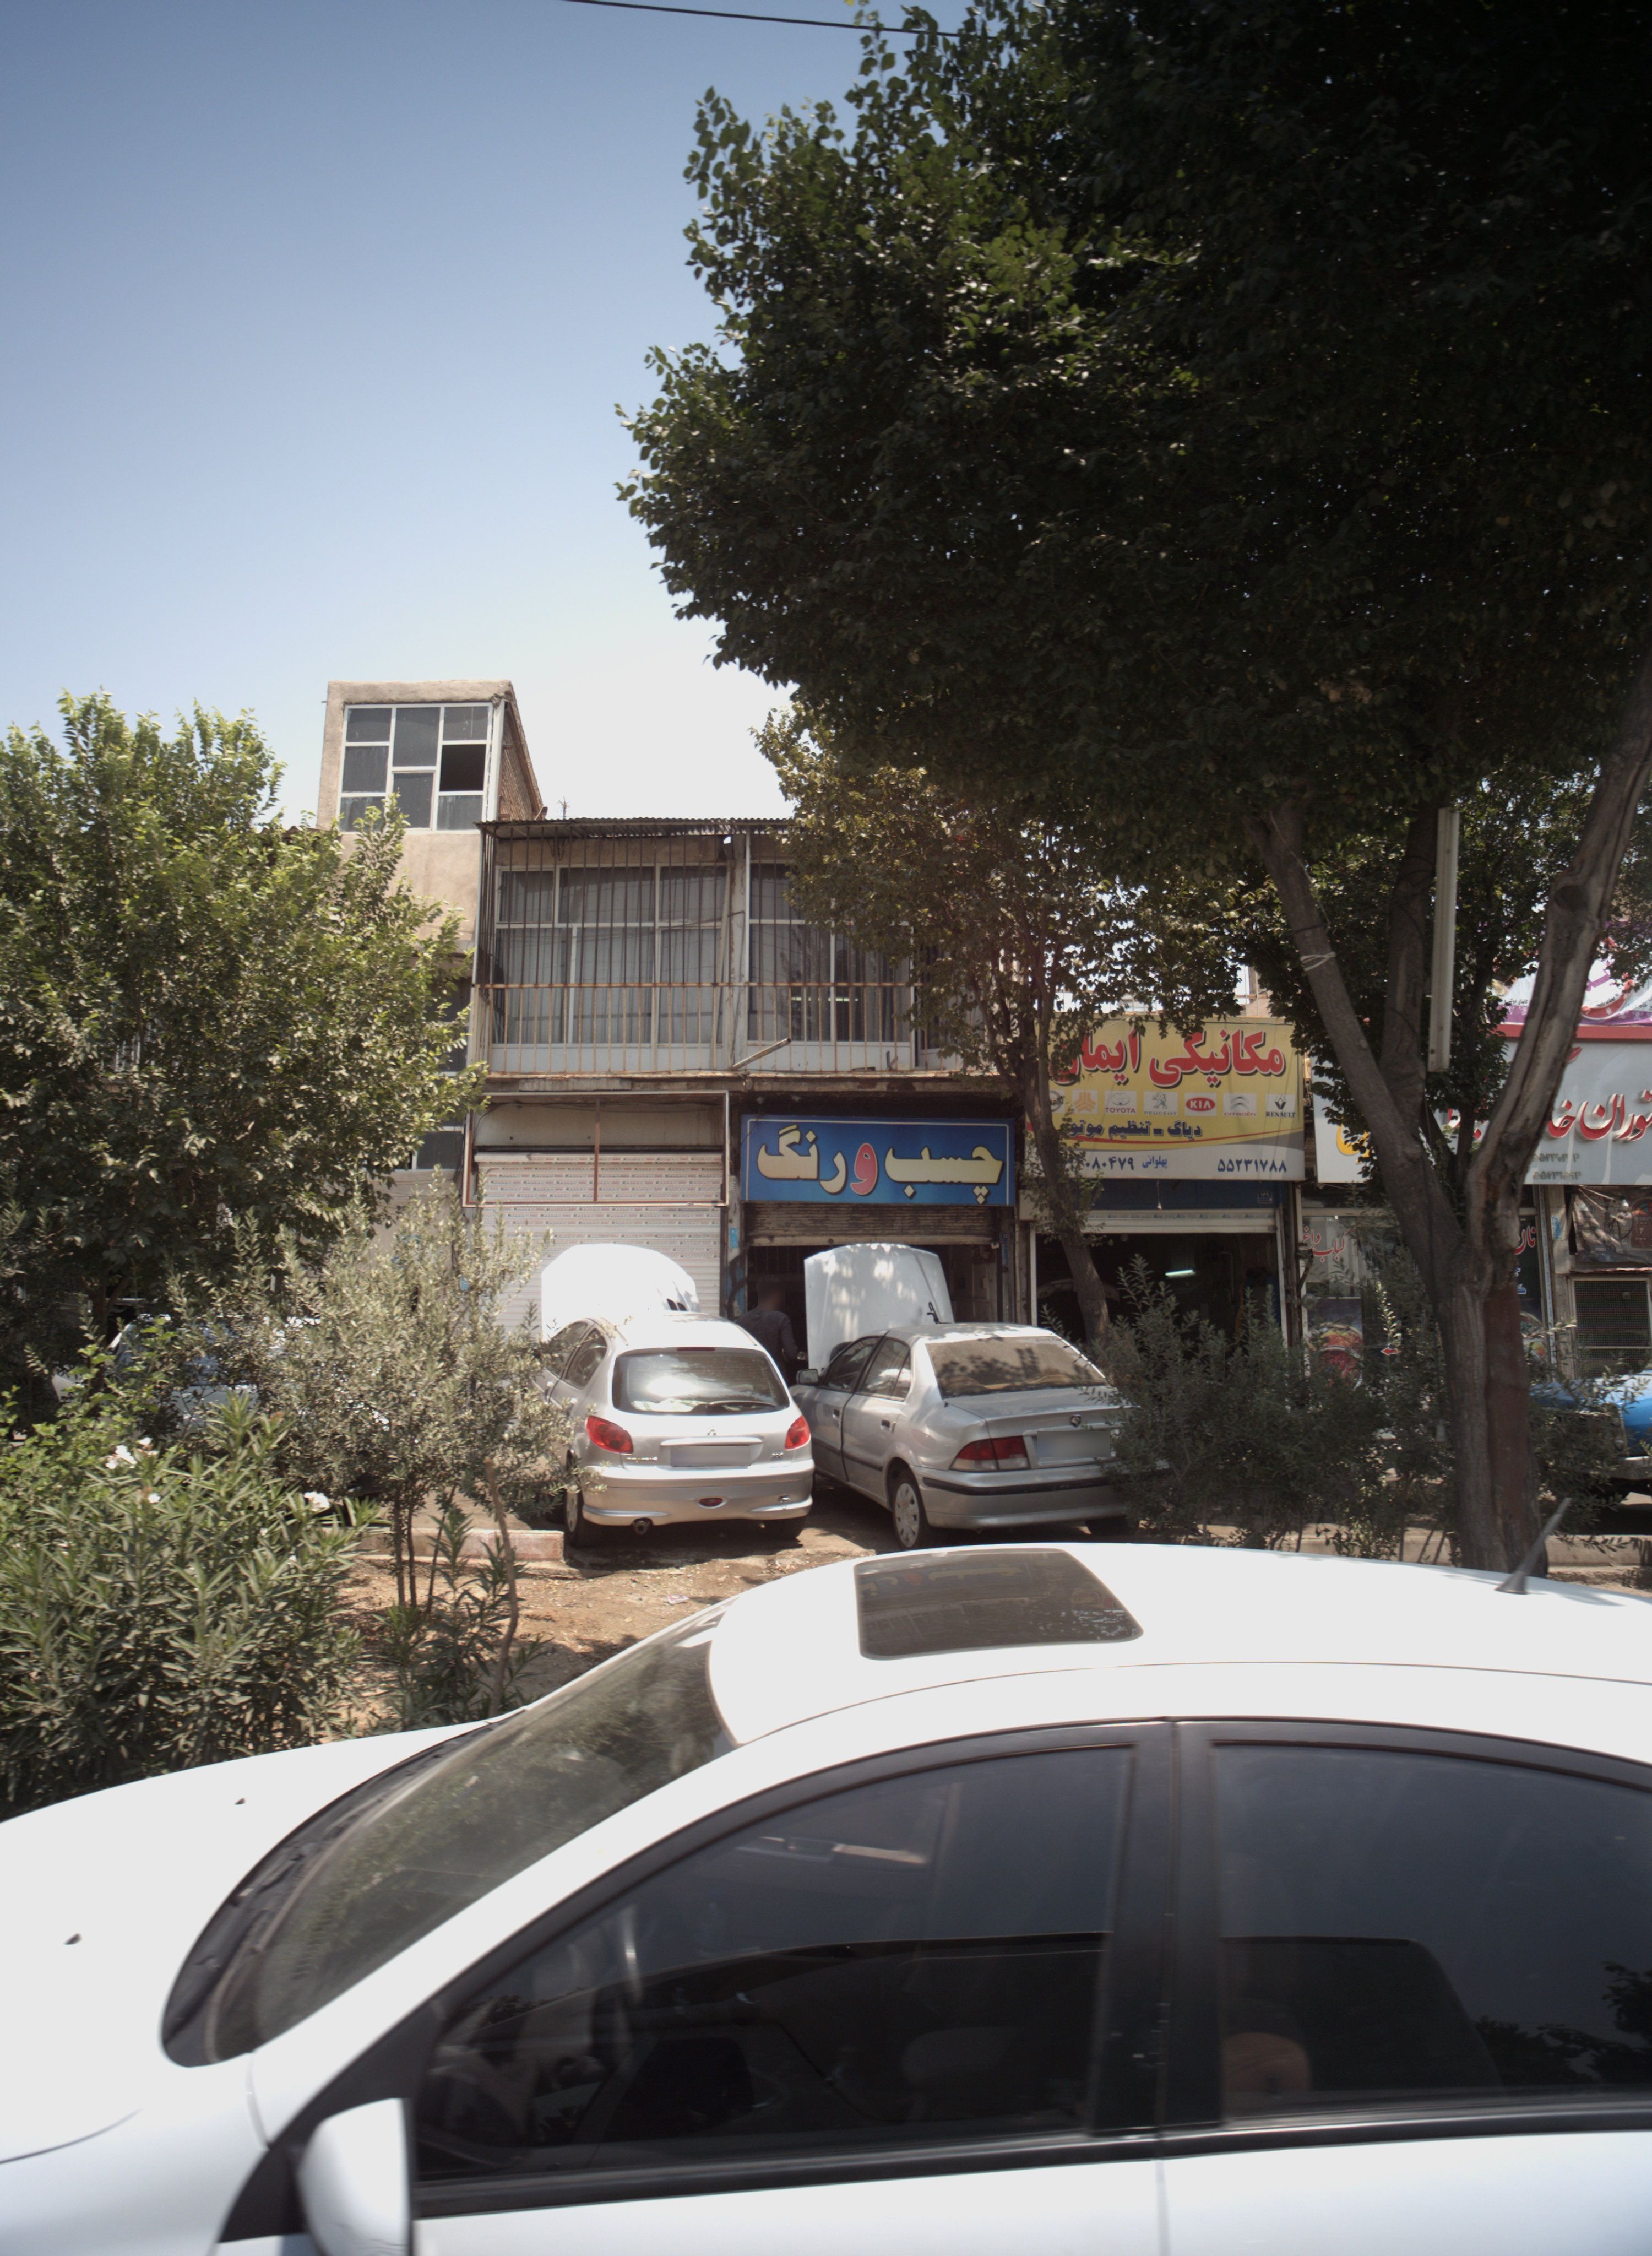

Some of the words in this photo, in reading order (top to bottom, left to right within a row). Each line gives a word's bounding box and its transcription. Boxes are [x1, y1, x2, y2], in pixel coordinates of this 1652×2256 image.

[1148, 1029, 1286, 1087] مکانیکی
[1061, 1119, 1104, 1138] موتو
[1108, 1120, 1151, 1140] تنظیم
[1189, 1100, 1211, 1110] KIA
[1577, 1089, 1652, 1142] توران
[757, 1124, 847, 1195] رنگ
[850, 1143, 878, 1196] و
[884, 1146, 1003, 1205] چسب
[1217, 1159, 1287, 1173] ۵۵۲۳۱۷۸۸
